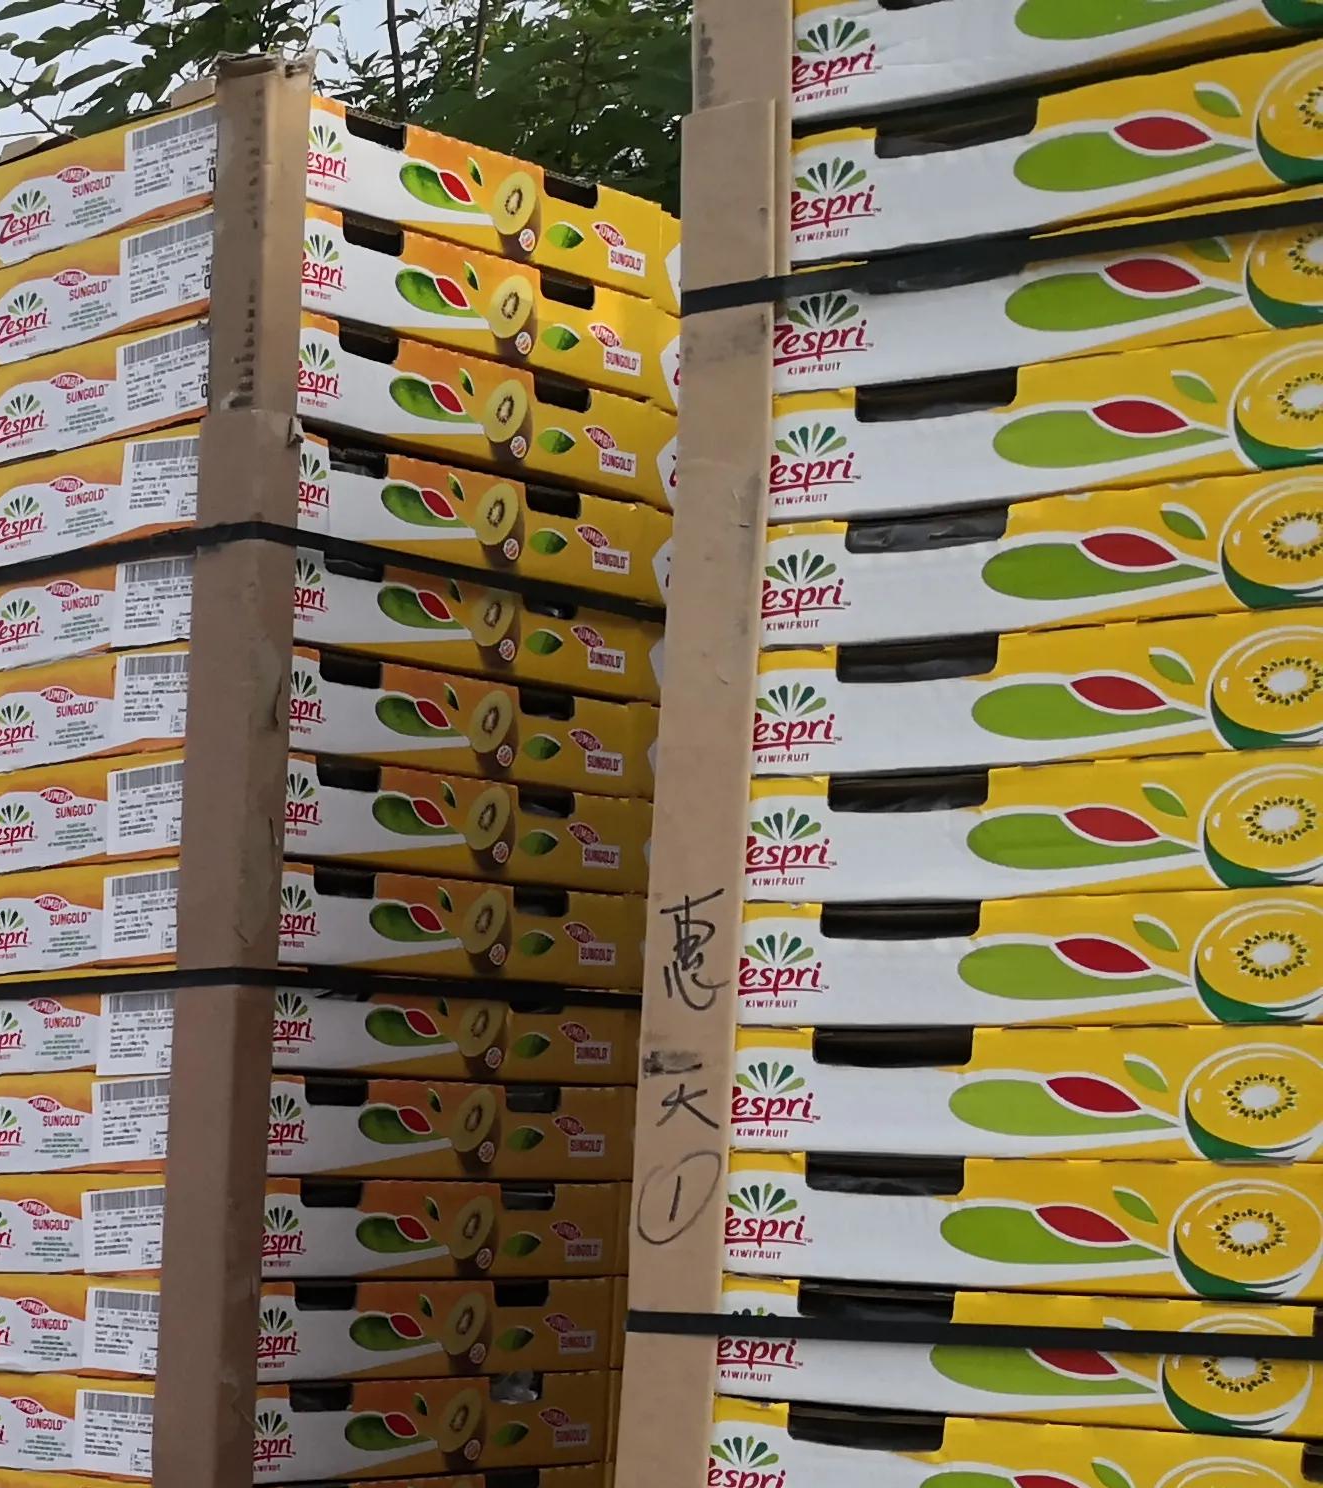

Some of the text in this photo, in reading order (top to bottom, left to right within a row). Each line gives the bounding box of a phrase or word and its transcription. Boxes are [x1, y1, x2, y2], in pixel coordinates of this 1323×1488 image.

[795, 86, 849, 103] KIWIFRUIT
[307, 144, 347, 181] espri
[72, 177, 110, 197] SUNGOLD
[0, 207, 51, 244] Zespri
[795, 228, 850, 243] KIWIFRUIT
[610, 250, 642, 271] SUNGOLD
[69, 281, 107, 301] SUNGOLD
[605, 350, 639, 371] SUNGOLD
[787, 362, 841, 375] KIWIFRUIT
[298, 362, 340, 397] espri
[66, 385, 104, 404] SUNGOLD
[65, 490, 104, 506] SUNGOLD
[774, 493, 828, 507] KIWIFRUIT
[766, 619, 820, 631] KIWIFRUIT
[757, 753, 810, 764] KIWIFRUIT
[55, 805, 93, 819] SUNGOLD
[584, 847, 618, 865] SUNGOLD
[752, 877, 805, 887] KIWIFRUIT
[745, 999, 798, 1009] KIWIFRUIT
[576, 1044, 609, 1061] SUNGOLD
[42, 1114, 79, 1126] SUNGOLD
[736, 1128, 789, 1139] KIWIFRUIT
[33, 1218, 69, 1231] SUNGOLD
[729, 1249, 782, 1260] KIWIFRUIT
[258, 1330, 301, 1357] espri
[25, 1416, 62, 1431] SUNGOLD
